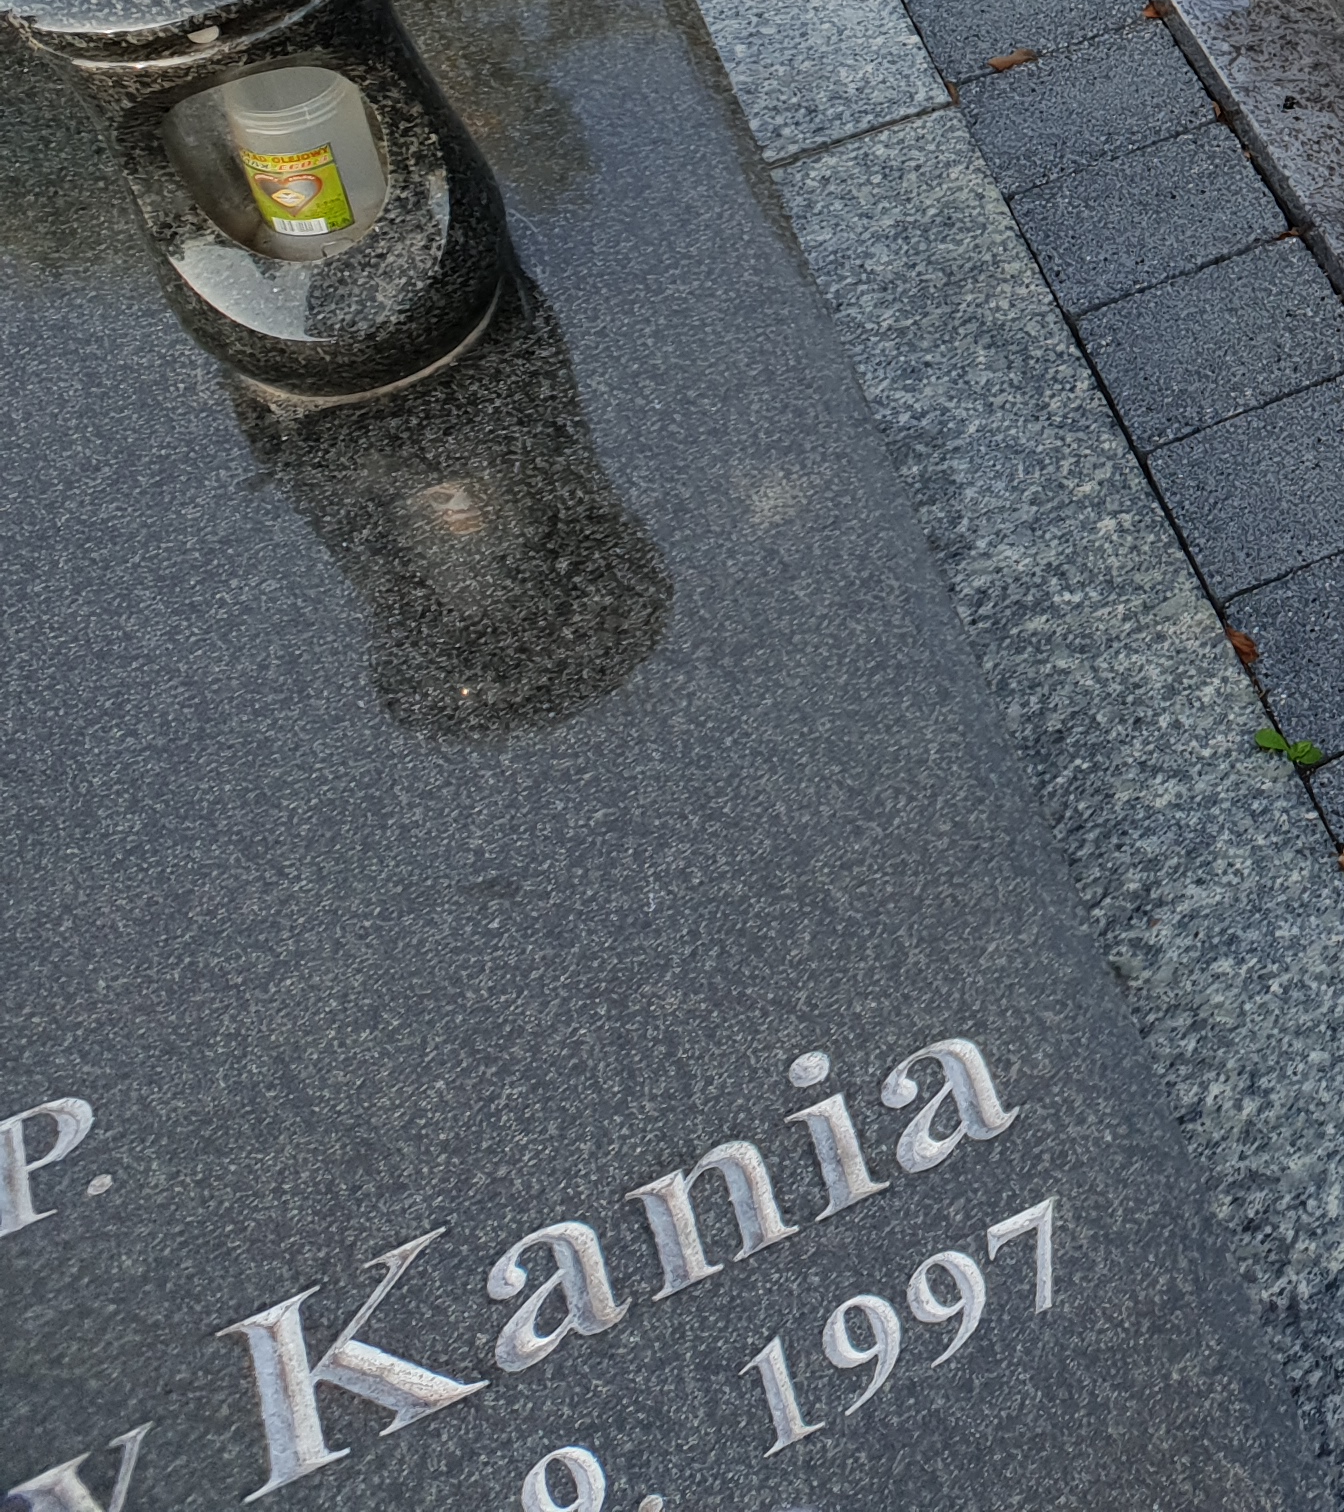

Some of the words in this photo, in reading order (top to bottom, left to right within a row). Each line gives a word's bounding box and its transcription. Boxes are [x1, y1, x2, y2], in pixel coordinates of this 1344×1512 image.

[271, 145, 328, 163] OLEJOWY
[216, 1039, 1020, 1503] Kania
[738, 1196, 1056, 1458] 1997
